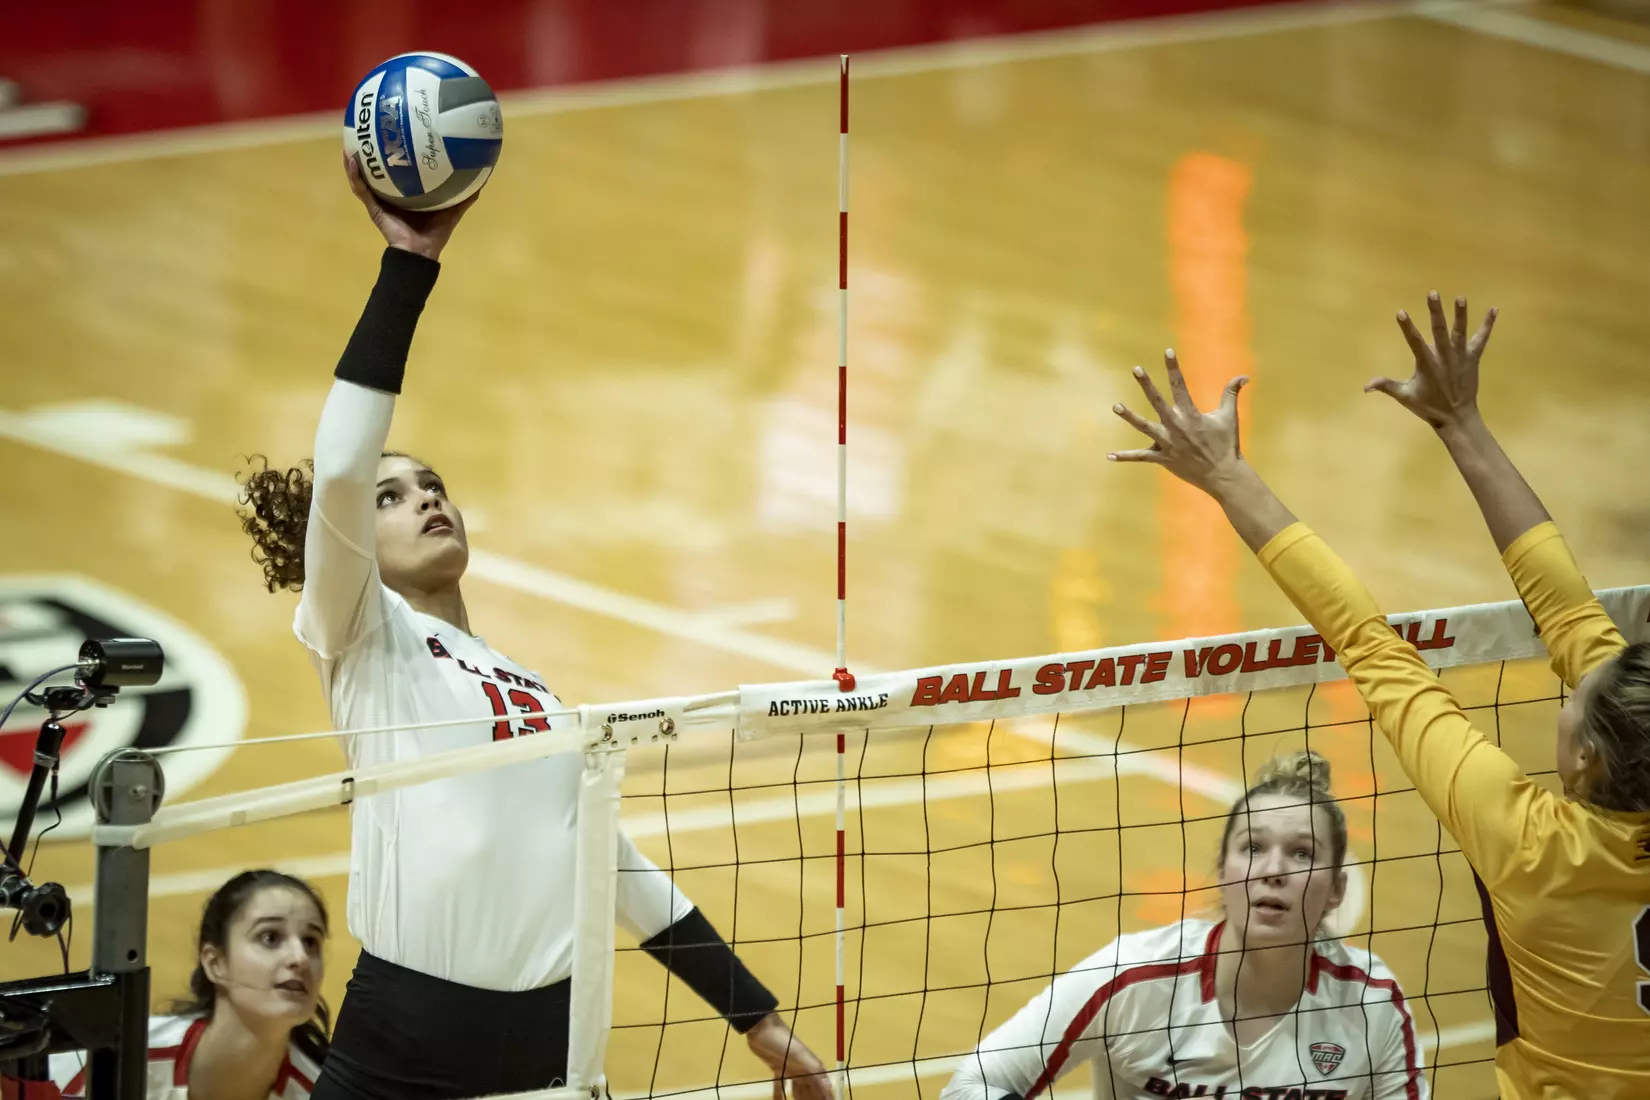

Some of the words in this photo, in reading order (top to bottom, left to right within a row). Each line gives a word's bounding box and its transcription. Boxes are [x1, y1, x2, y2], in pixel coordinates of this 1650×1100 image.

[413, 87, 434, 128] Touch
[356, 91, 386, 181] molten
[379, 96, 412, 168] NCAA
[421, 132, 442, 171] Super
[910, 668, 1021, 708] BALL
[1032, 651, 1172, 695] STATE
[481, 680, 551, 742] 13
[617, 709, 666, 723] Senoh
[767, 697, 831, 718] ACTIVE
[835, 693, 890, 713] ANKLE
[1312, 1051, 1343, 1064] MAC
